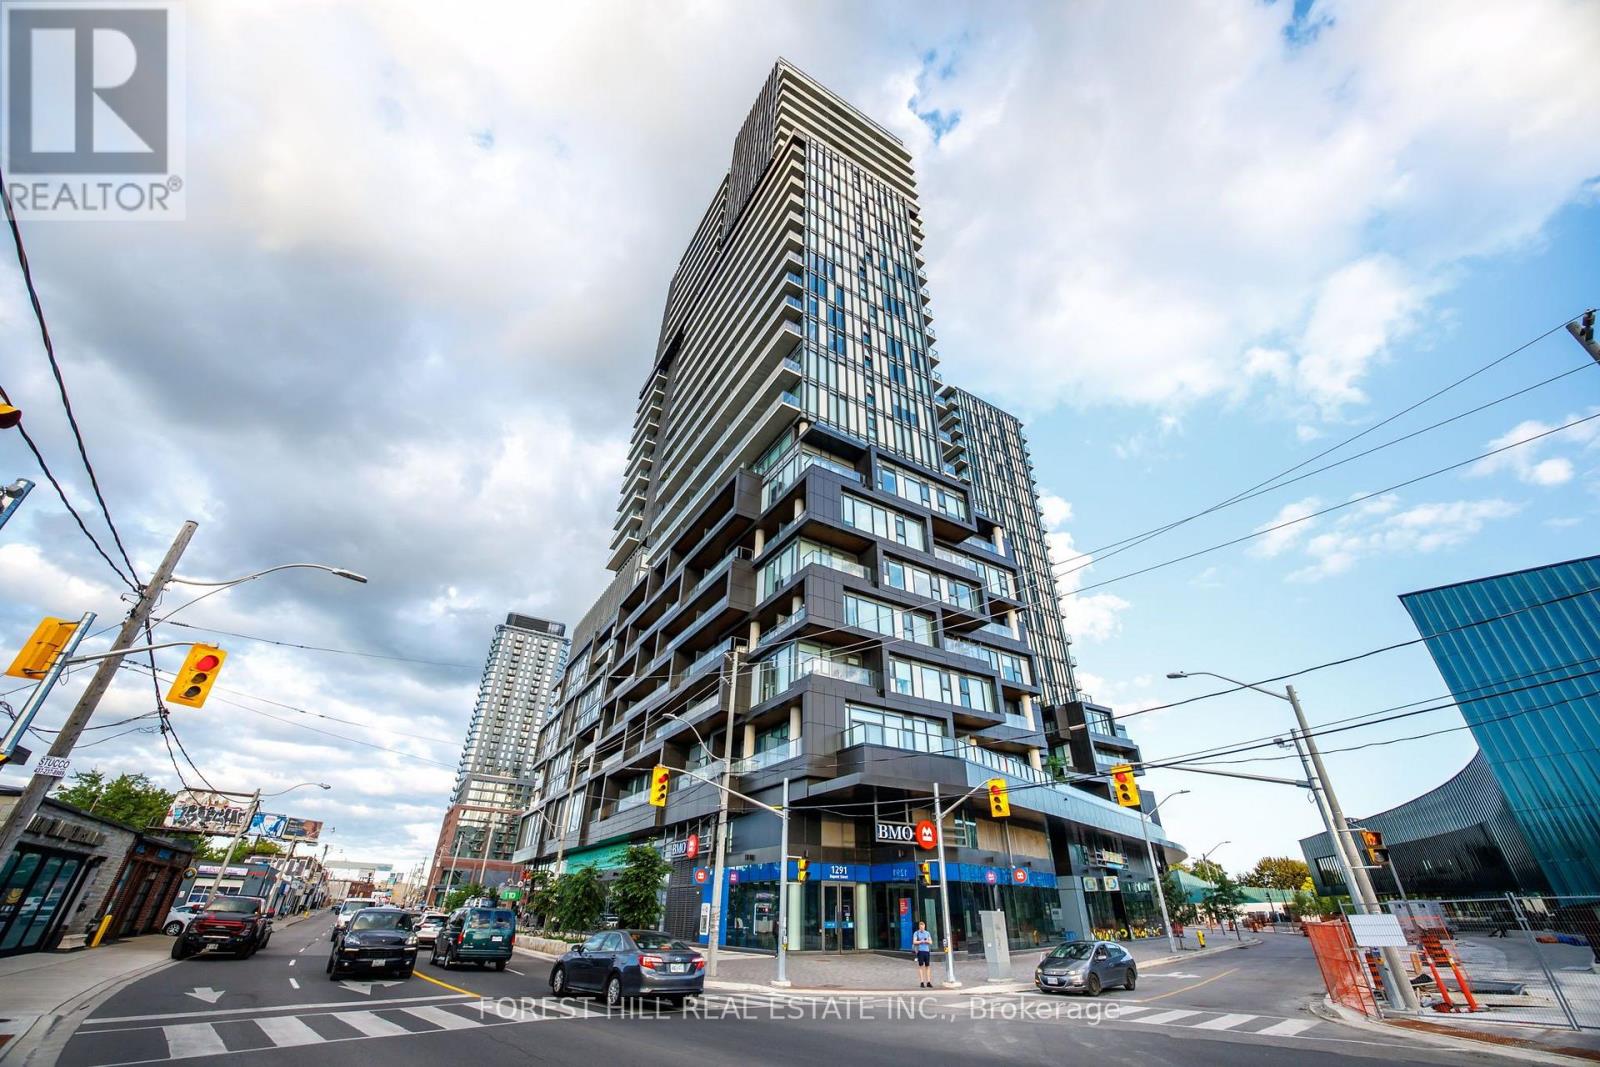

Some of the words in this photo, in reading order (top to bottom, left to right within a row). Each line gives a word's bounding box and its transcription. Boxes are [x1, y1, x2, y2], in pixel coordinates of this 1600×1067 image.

[39, 757, 71, 769] STUCCO
[878, 824, 913, 841] BMO
[672, 842, 687, 855] BMO
[831, 865, 847, 875] 1291
